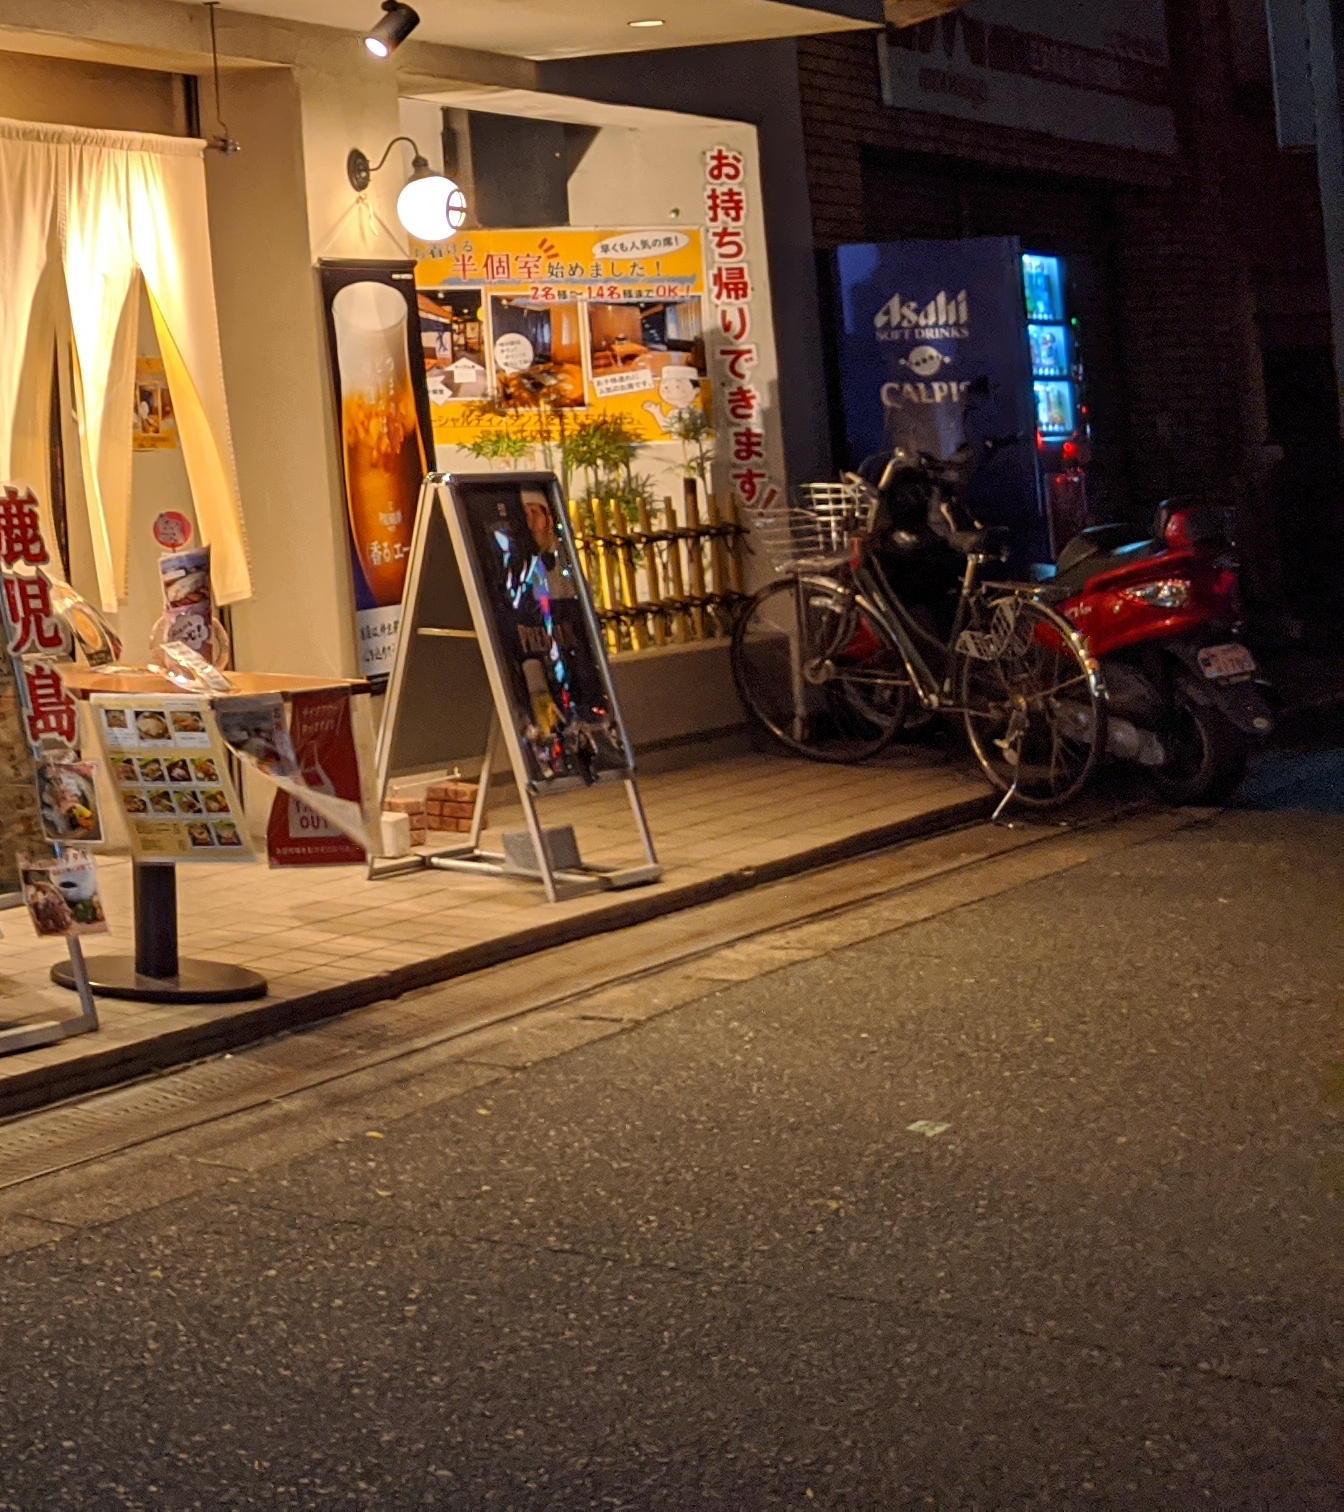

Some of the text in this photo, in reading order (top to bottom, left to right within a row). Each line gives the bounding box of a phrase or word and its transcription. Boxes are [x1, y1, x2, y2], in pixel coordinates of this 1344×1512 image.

[873, 289, 969, 328] Asahi
[707, 148, 779, 514] お持ち帰りできます！
[914, 328, 970, 340] DRINKS
